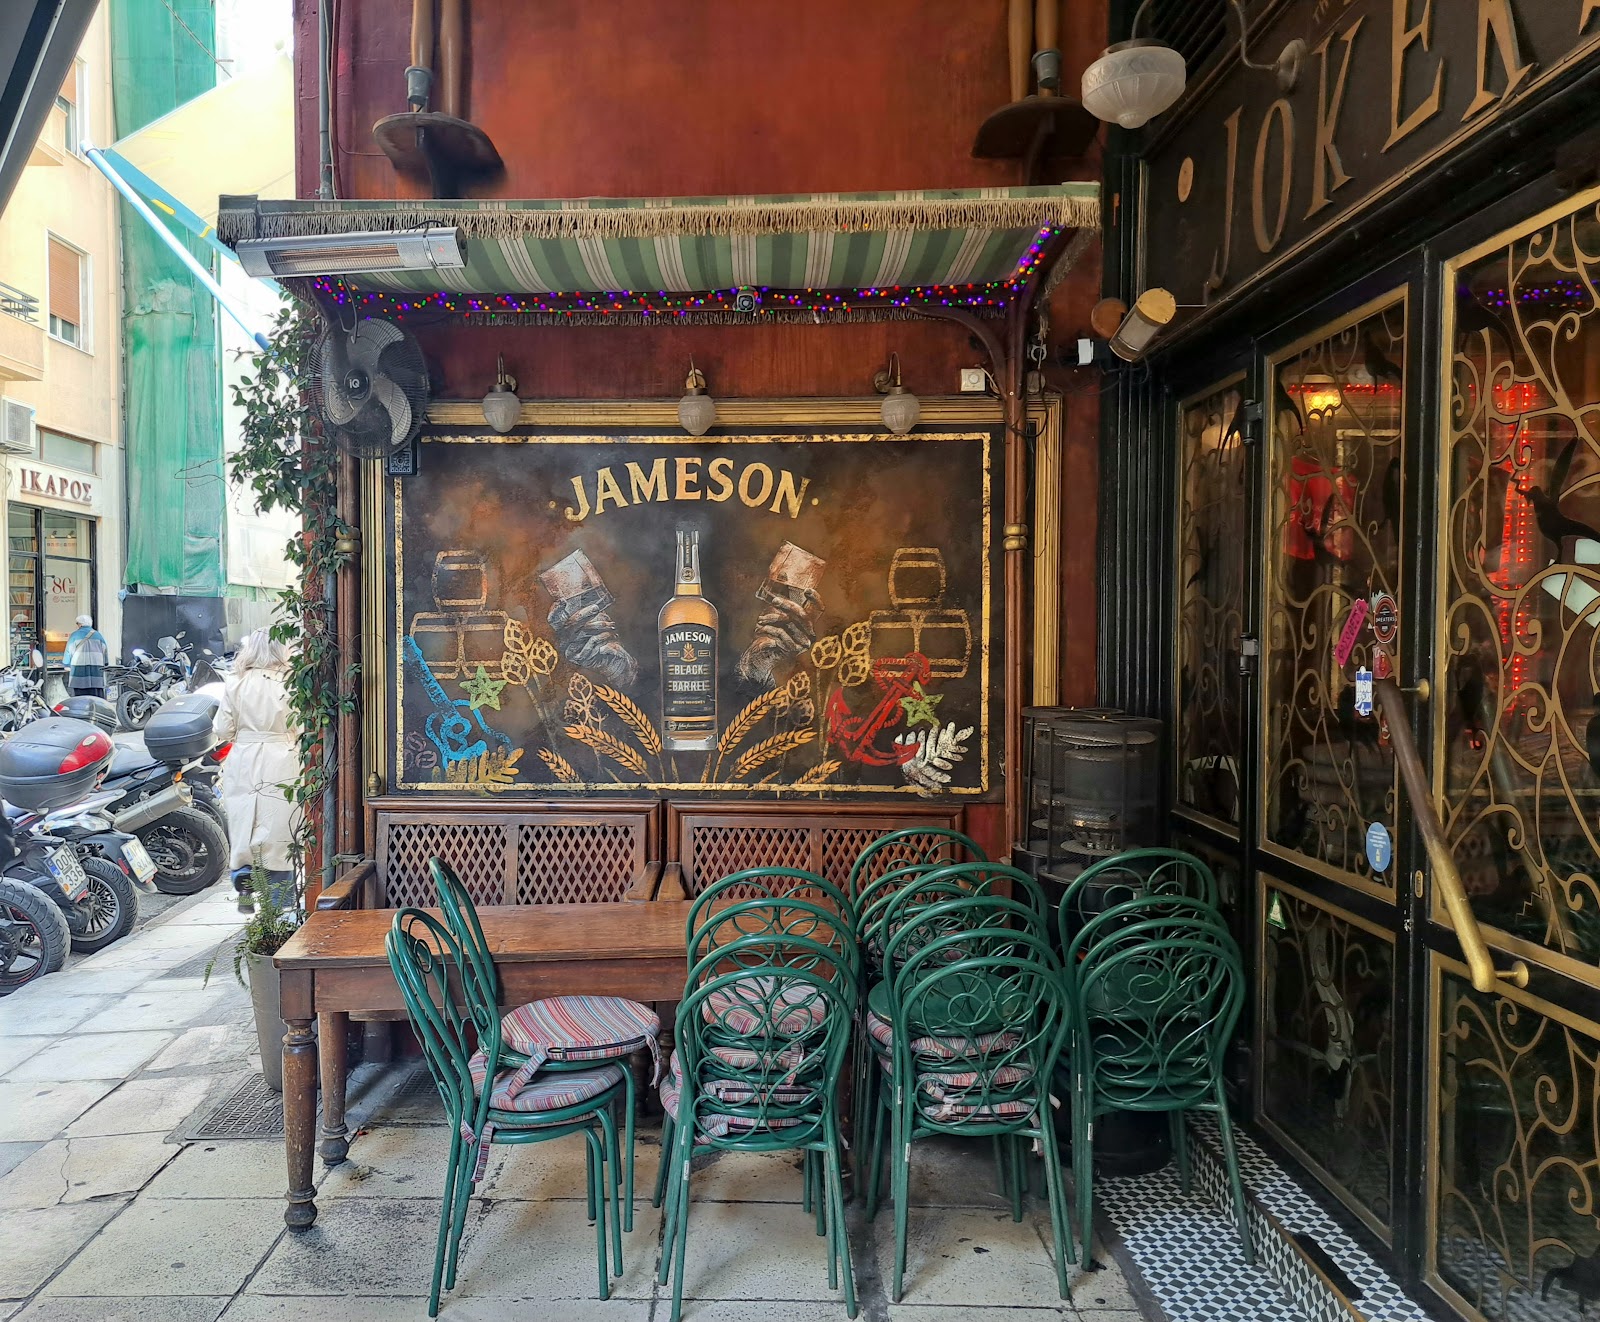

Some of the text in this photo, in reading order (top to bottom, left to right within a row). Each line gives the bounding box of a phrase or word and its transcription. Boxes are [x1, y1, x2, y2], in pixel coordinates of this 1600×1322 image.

[20, 468, 92, 502] ΙΚΑΡΟΣ
[564, 457, 812, 522] JAMESON
[665, 631, 712, 646] JAMESON
[674, 664, 704, 675] BLACK
[672, 680, 706, 692] BARREL
[65, 865, 84, 886] 336
